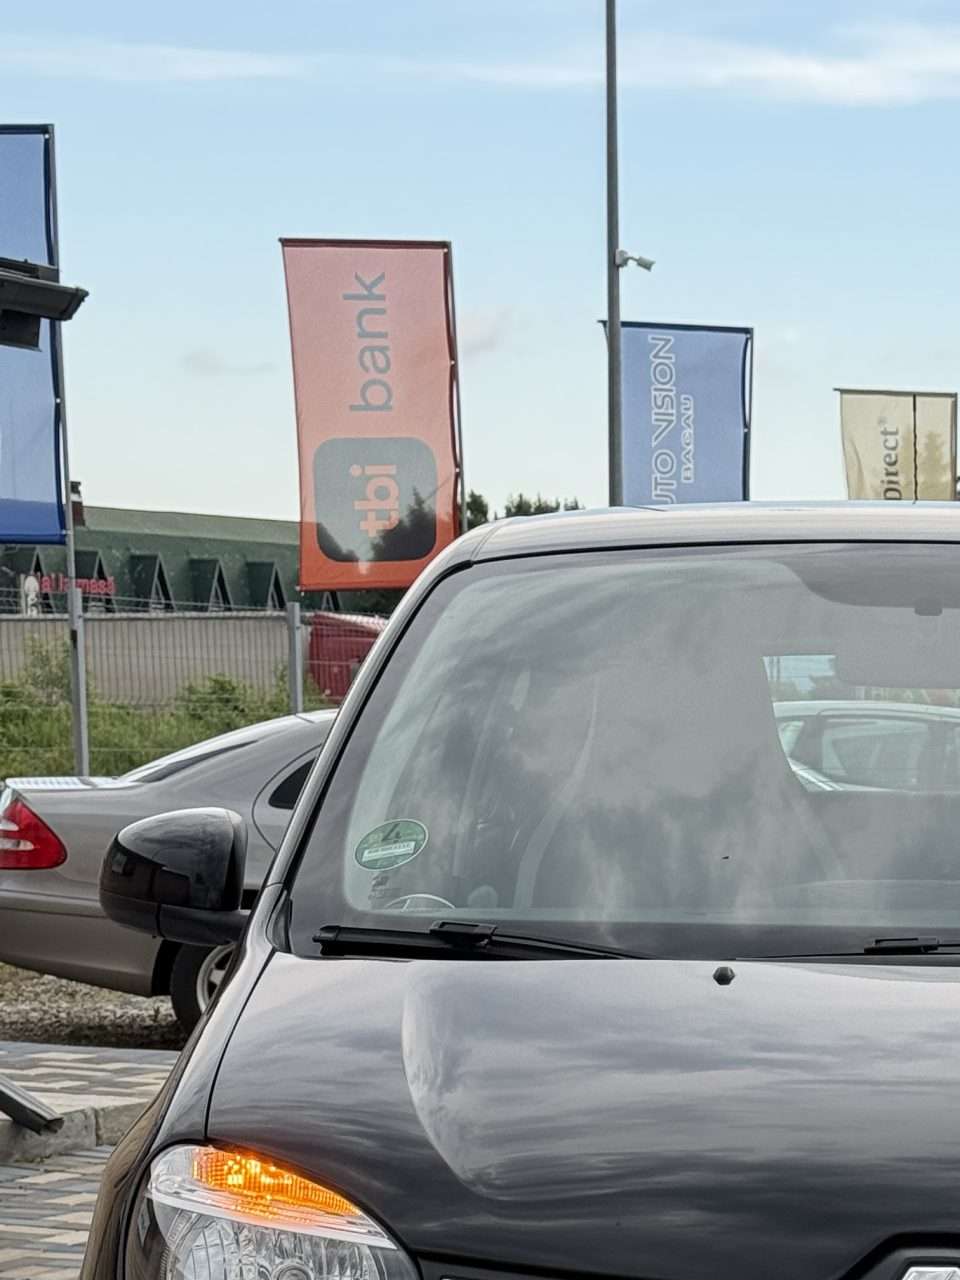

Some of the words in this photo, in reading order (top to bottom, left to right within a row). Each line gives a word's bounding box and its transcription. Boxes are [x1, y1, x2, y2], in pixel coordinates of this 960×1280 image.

[342, 271, 394, 412] bank
[648, 334, 676, 448] VISION
[681, 394, 695, 483] BACAU
[349, 463, 401, 538] tbi
